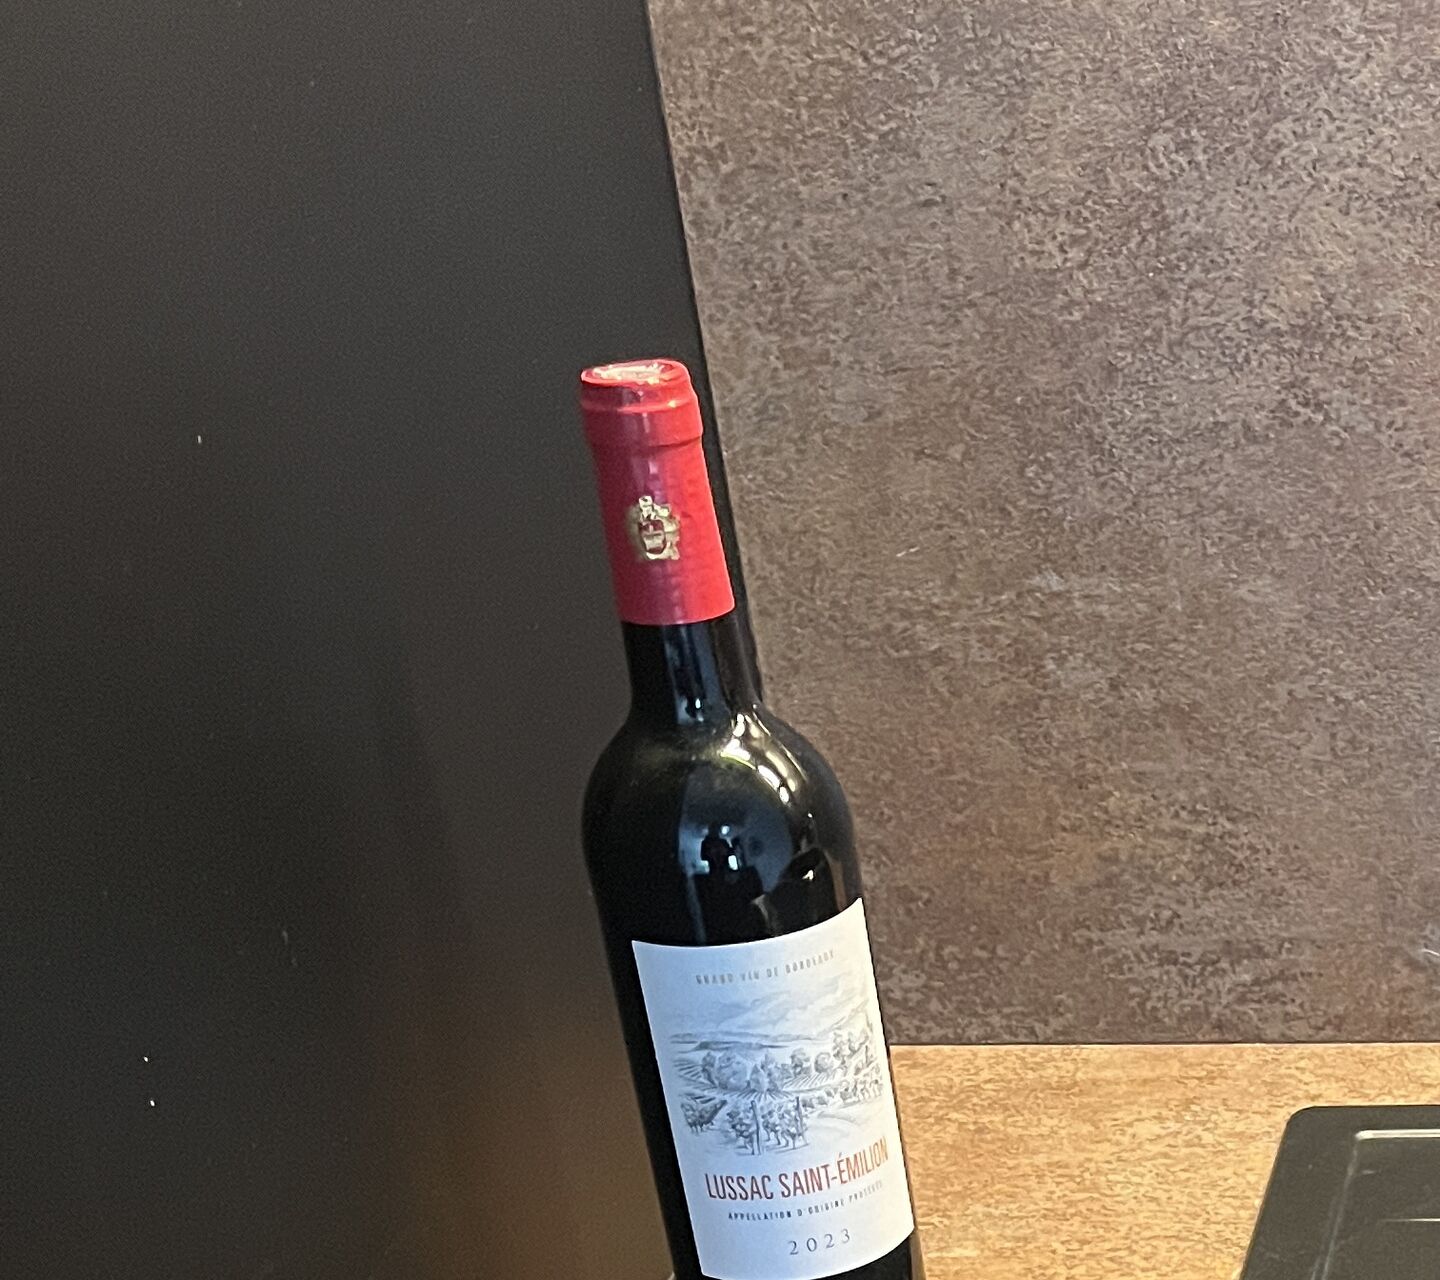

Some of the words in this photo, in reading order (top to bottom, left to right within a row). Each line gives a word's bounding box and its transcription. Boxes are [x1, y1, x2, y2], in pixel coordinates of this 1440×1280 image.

[705, 1173, 774, 1201] LUSSAC
[778, 1135, 890, 1198] SAINT-ÉMILION
[789, 1228, 851, 1256] 2023
